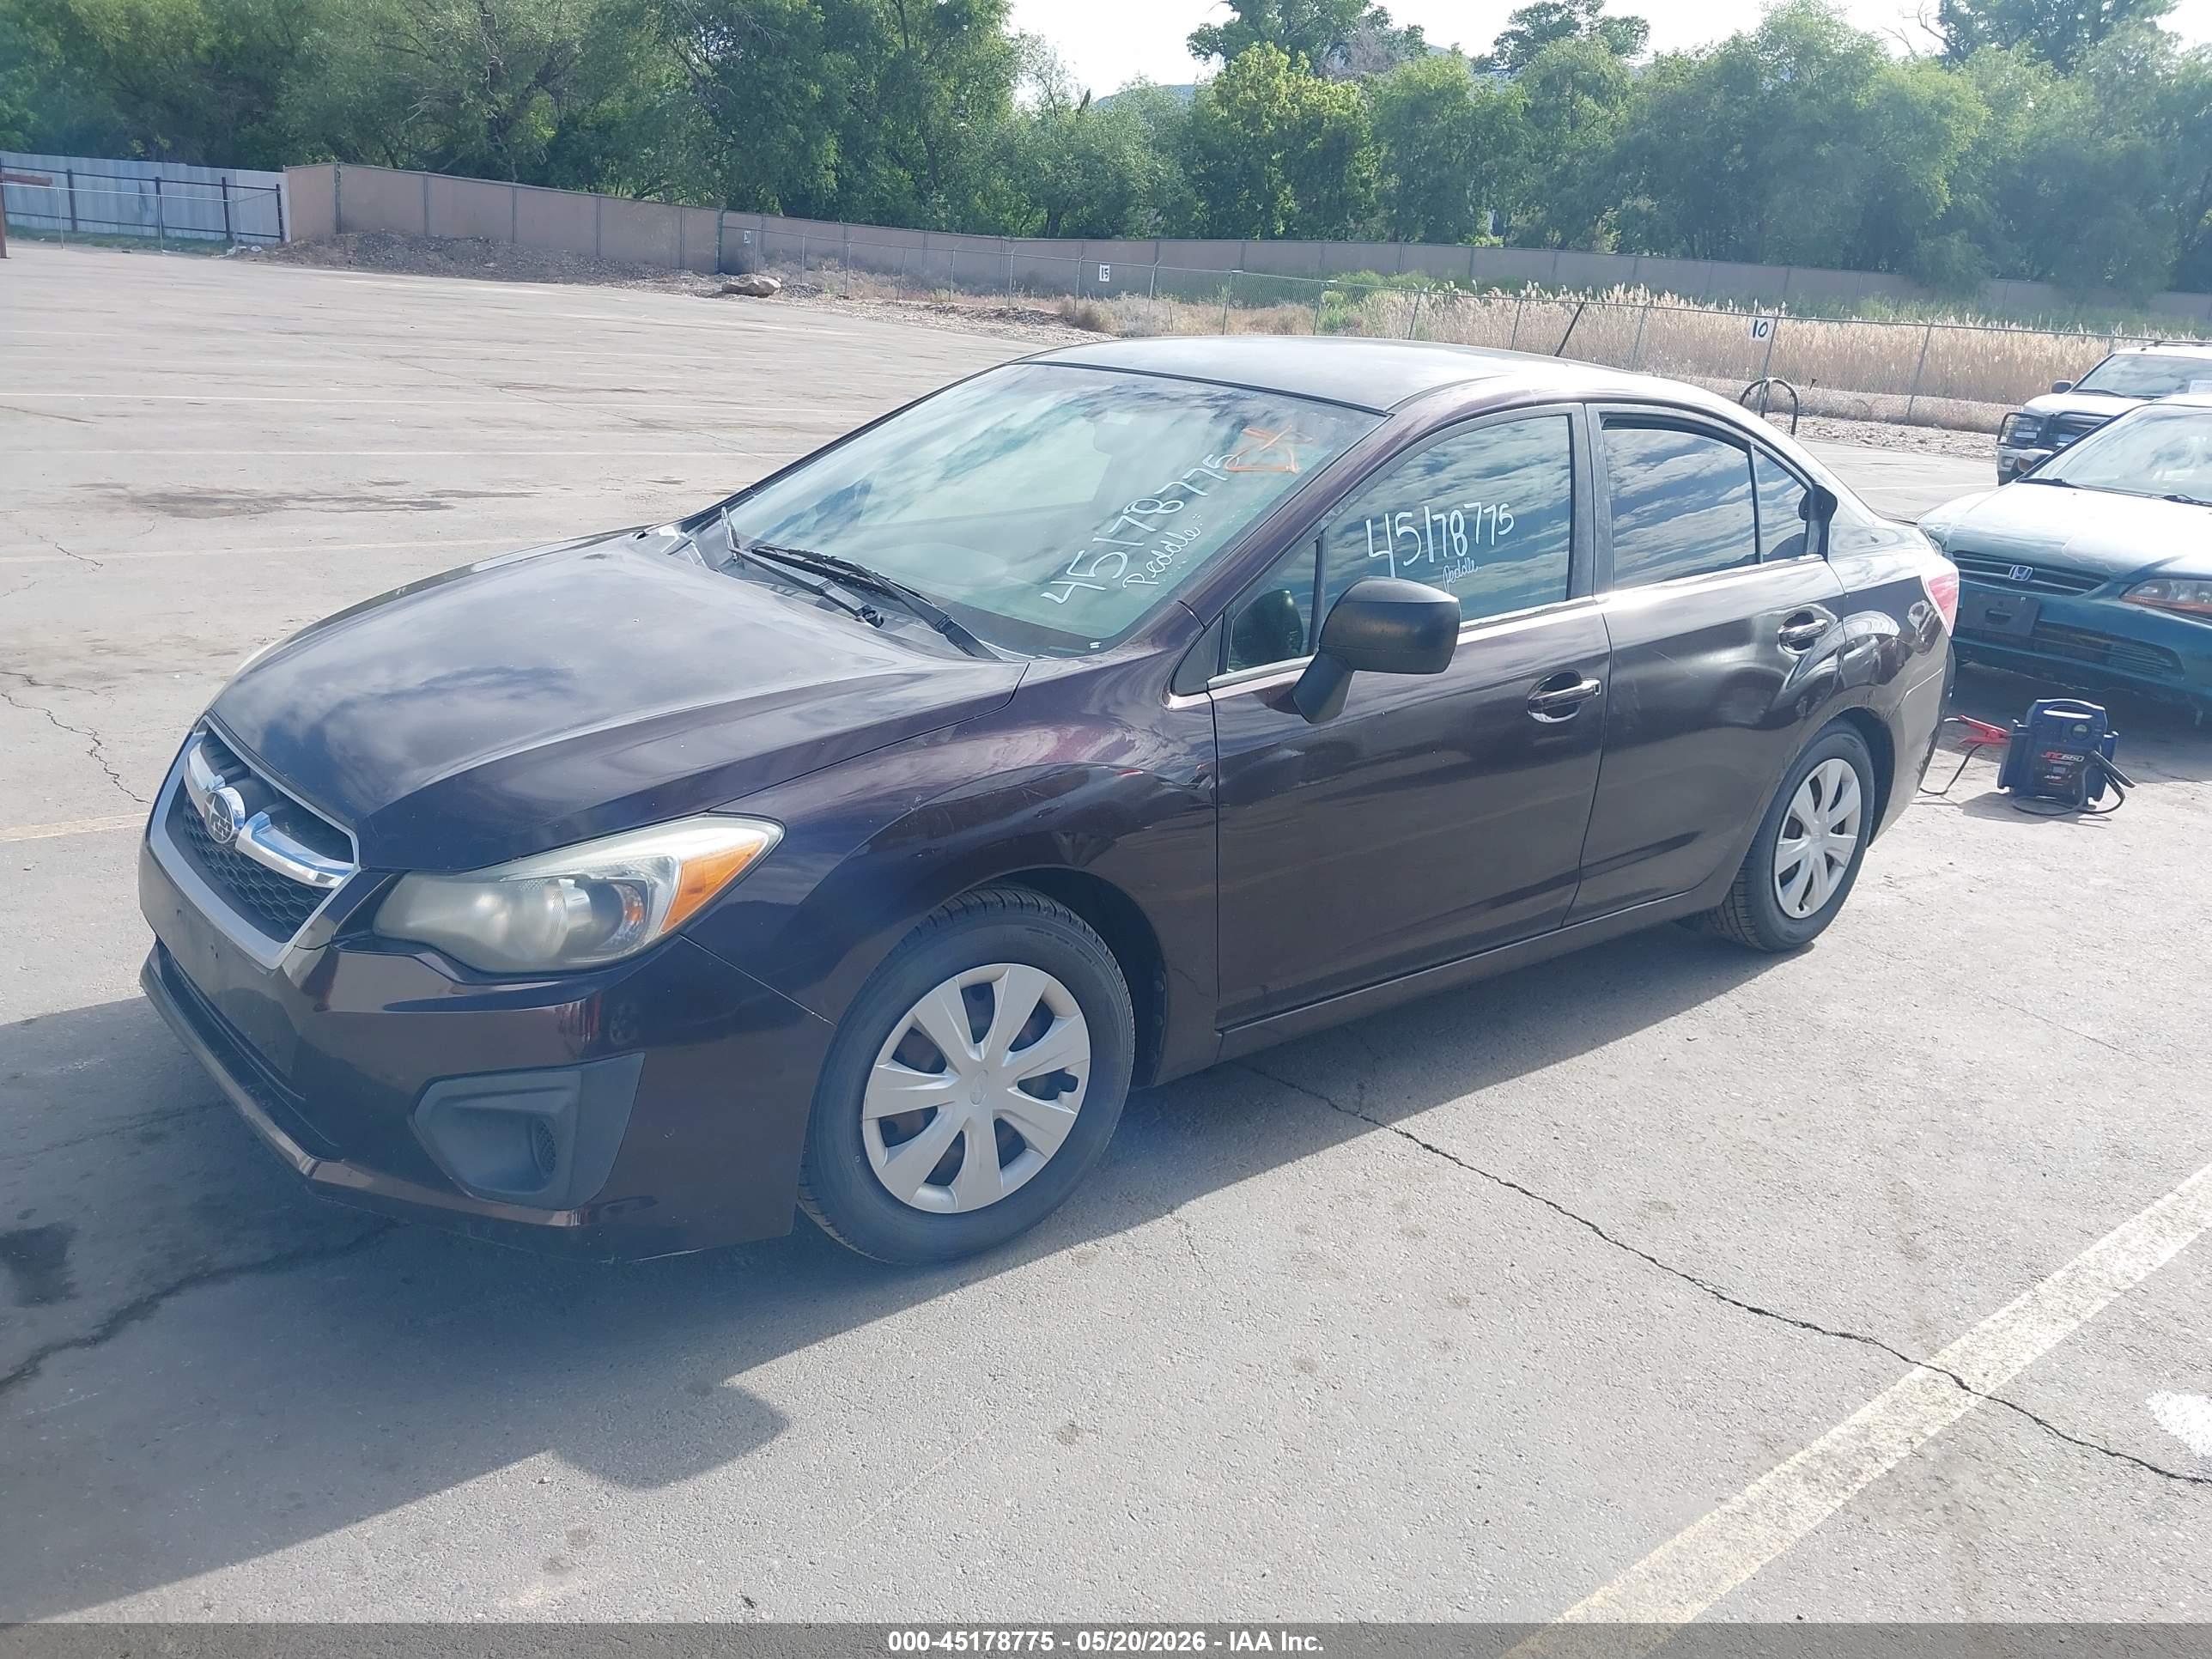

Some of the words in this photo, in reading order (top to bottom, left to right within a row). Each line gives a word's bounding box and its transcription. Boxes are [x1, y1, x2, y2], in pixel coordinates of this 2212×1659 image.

[1101, 267, 1109, 279] 15
[1753, 319, 1769, 337] 10
[1040, 453, 1239, 604] 45178775
[1365, 501, 1515, 578] 45178775
